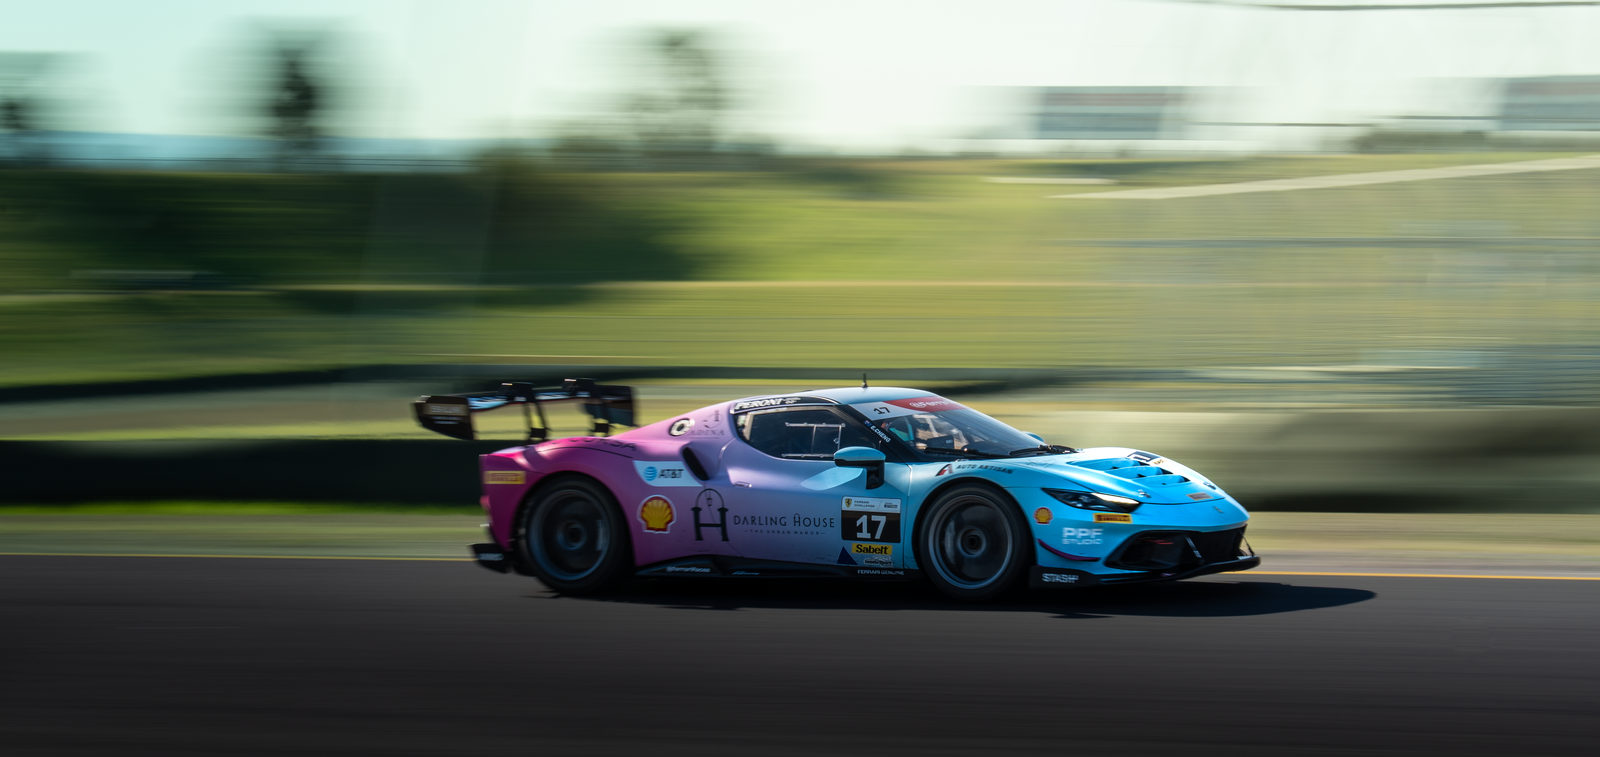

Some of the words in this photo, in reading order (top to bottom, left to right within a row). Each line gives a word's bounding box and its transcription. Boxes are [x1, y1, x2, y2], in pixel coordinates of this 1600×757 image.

[873, 406, 891, 415] 17
[658, 468, 684, 479] AT&T
[733, 514, 787, 526] DARLING
[793, 513, 835, 528] HOUSE
[856, 514, 887, 539] 17
[1063, 527, 1104, 538] PPF
[855, 544, 889, 555] Sabelt
